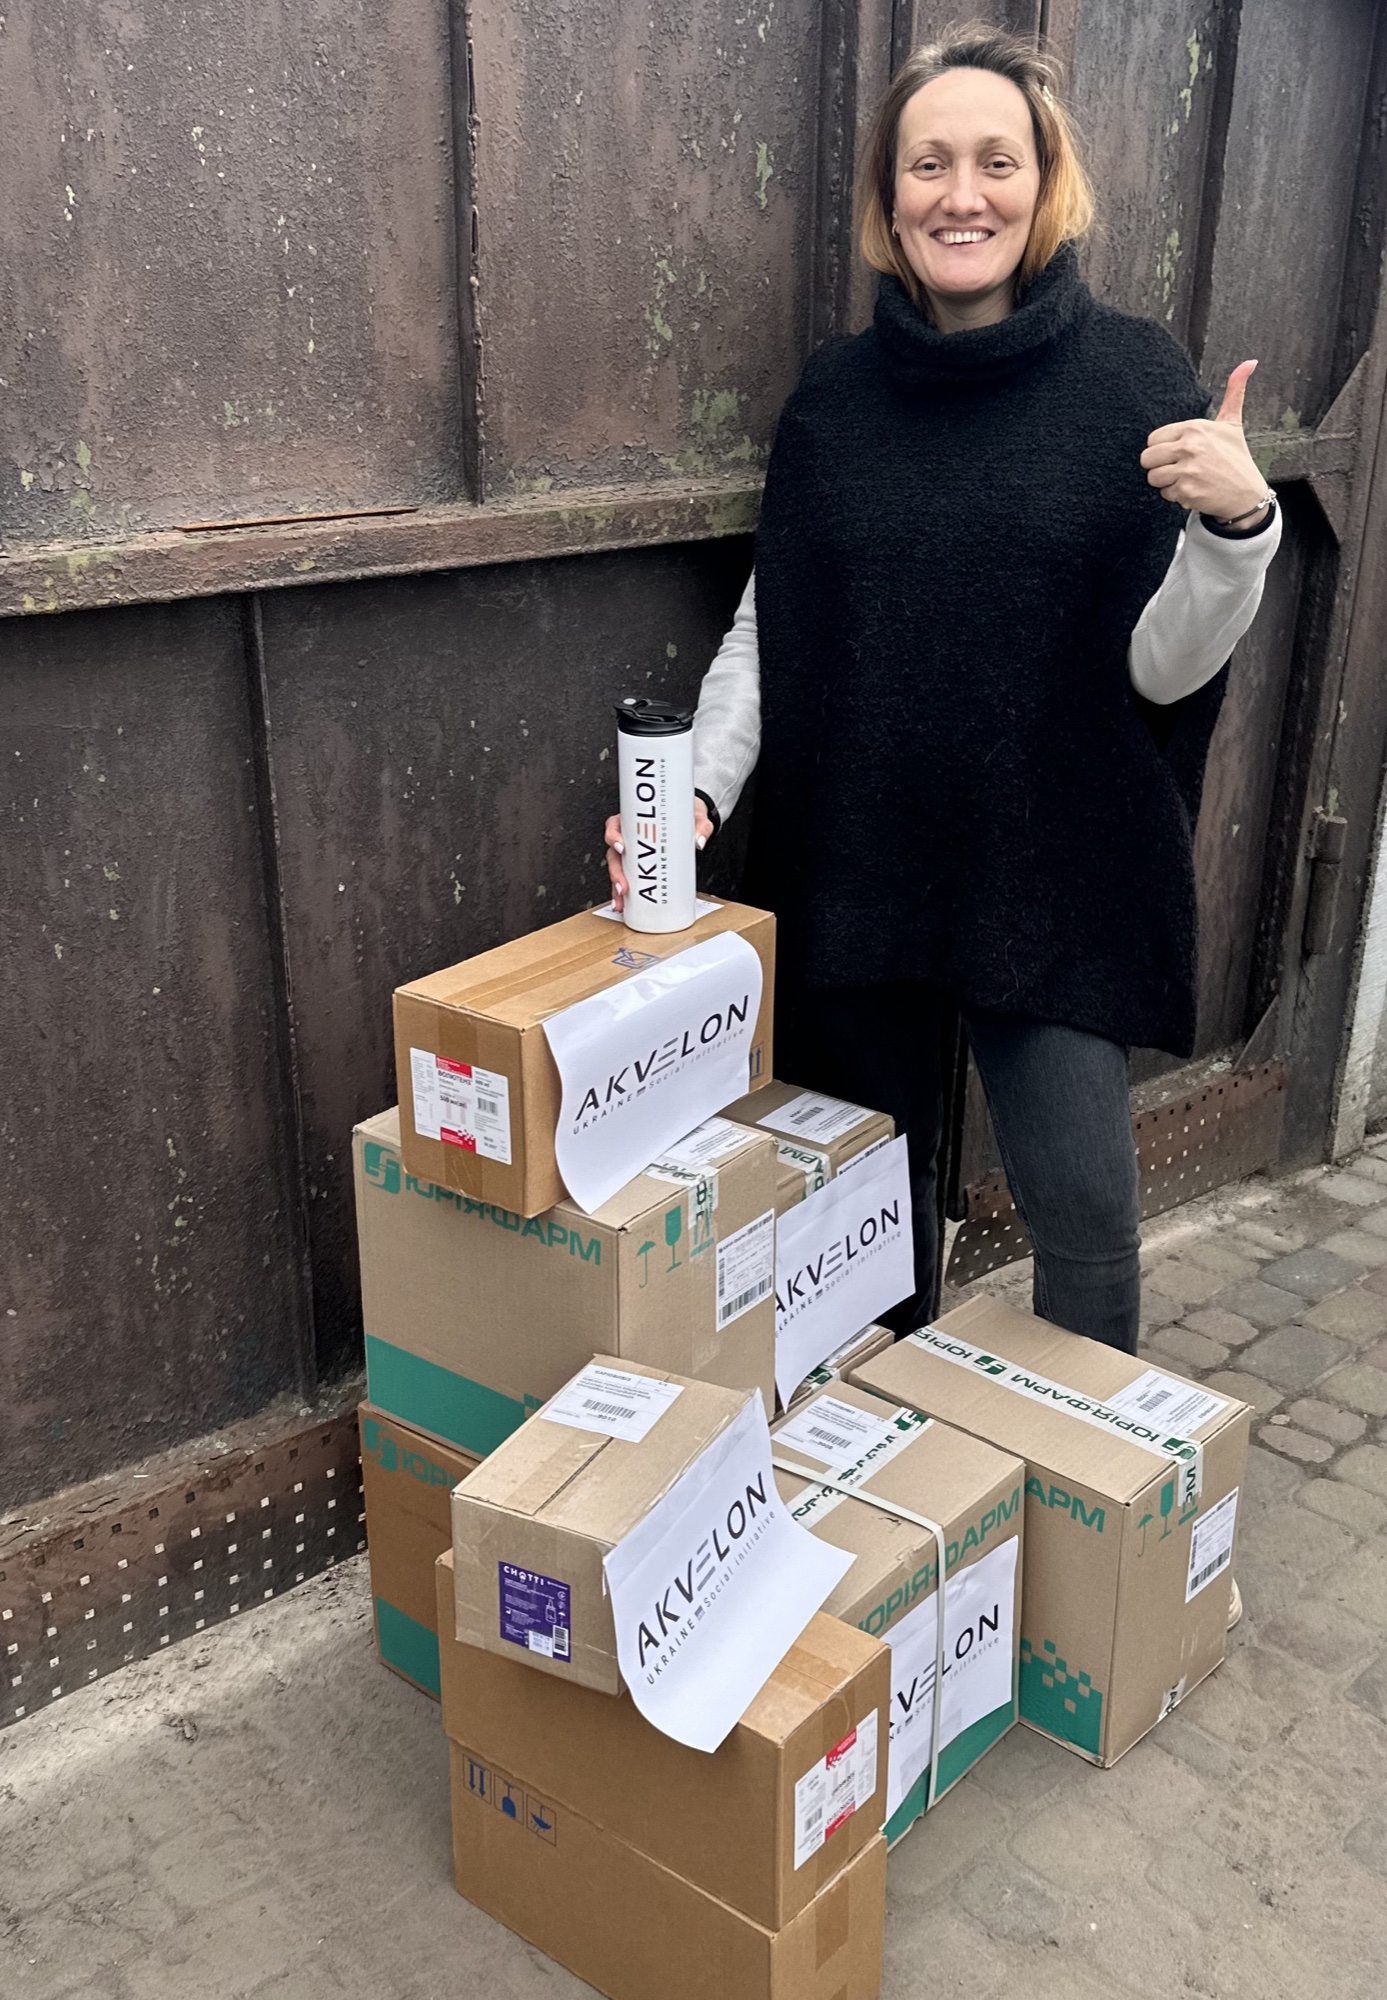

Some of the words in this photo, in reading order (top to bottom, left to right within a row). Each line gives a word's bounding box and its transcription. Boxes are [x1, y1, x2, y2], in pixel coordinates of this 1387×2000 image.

[635, 757, 658, 905] AKVELON
[659, 758, 667, 807] initiative
[660, 812, 668, 844] Social
[572, 1094, 633, 1135] UKRAINE
[648, 1064, 687, 1090] Social
[690, 1028, 745, 1069] initiative
[575, 994, 749, 1121] AKVELON
[775, 1297, 813, 1339] KRAINE
[825, 1264, 853, 1292] Social
[857, 1230, 902, 1267] initiative
[1010, 1374, 1160, 1442] ЮРІЯ-ФАРМ
[503, 1565, 545, 1586] CHOTTI
[639, 1471, 768, 1668] AKVELON
[646, 1618, 696, 1685] UKRAINE
[702, 1565, 734, 1609] Social
[733, 1510, 776, 1567] initiative
[949, 1636, 1000, 1682] initiative
